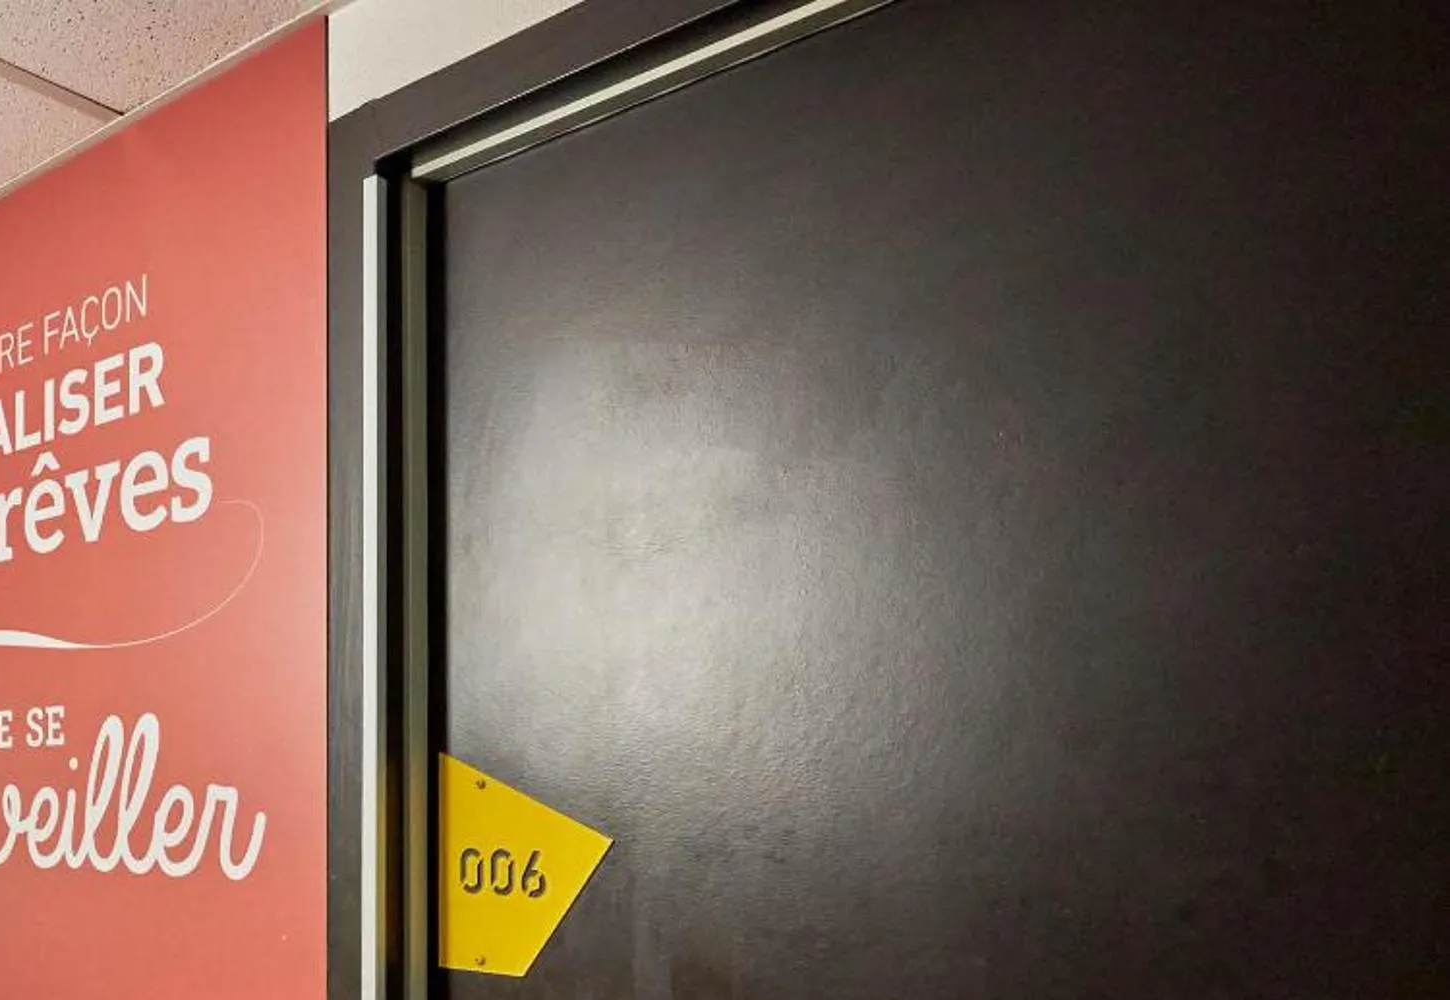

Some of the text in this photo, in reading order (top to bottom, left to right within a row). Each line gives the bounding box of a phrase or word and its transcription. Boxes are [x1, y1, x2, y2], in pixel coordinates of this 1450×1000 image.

[43, 274, 149, 355] FAÇON
[23, 704, 67, 749] SE
[459, 847, 546, 898] 006
